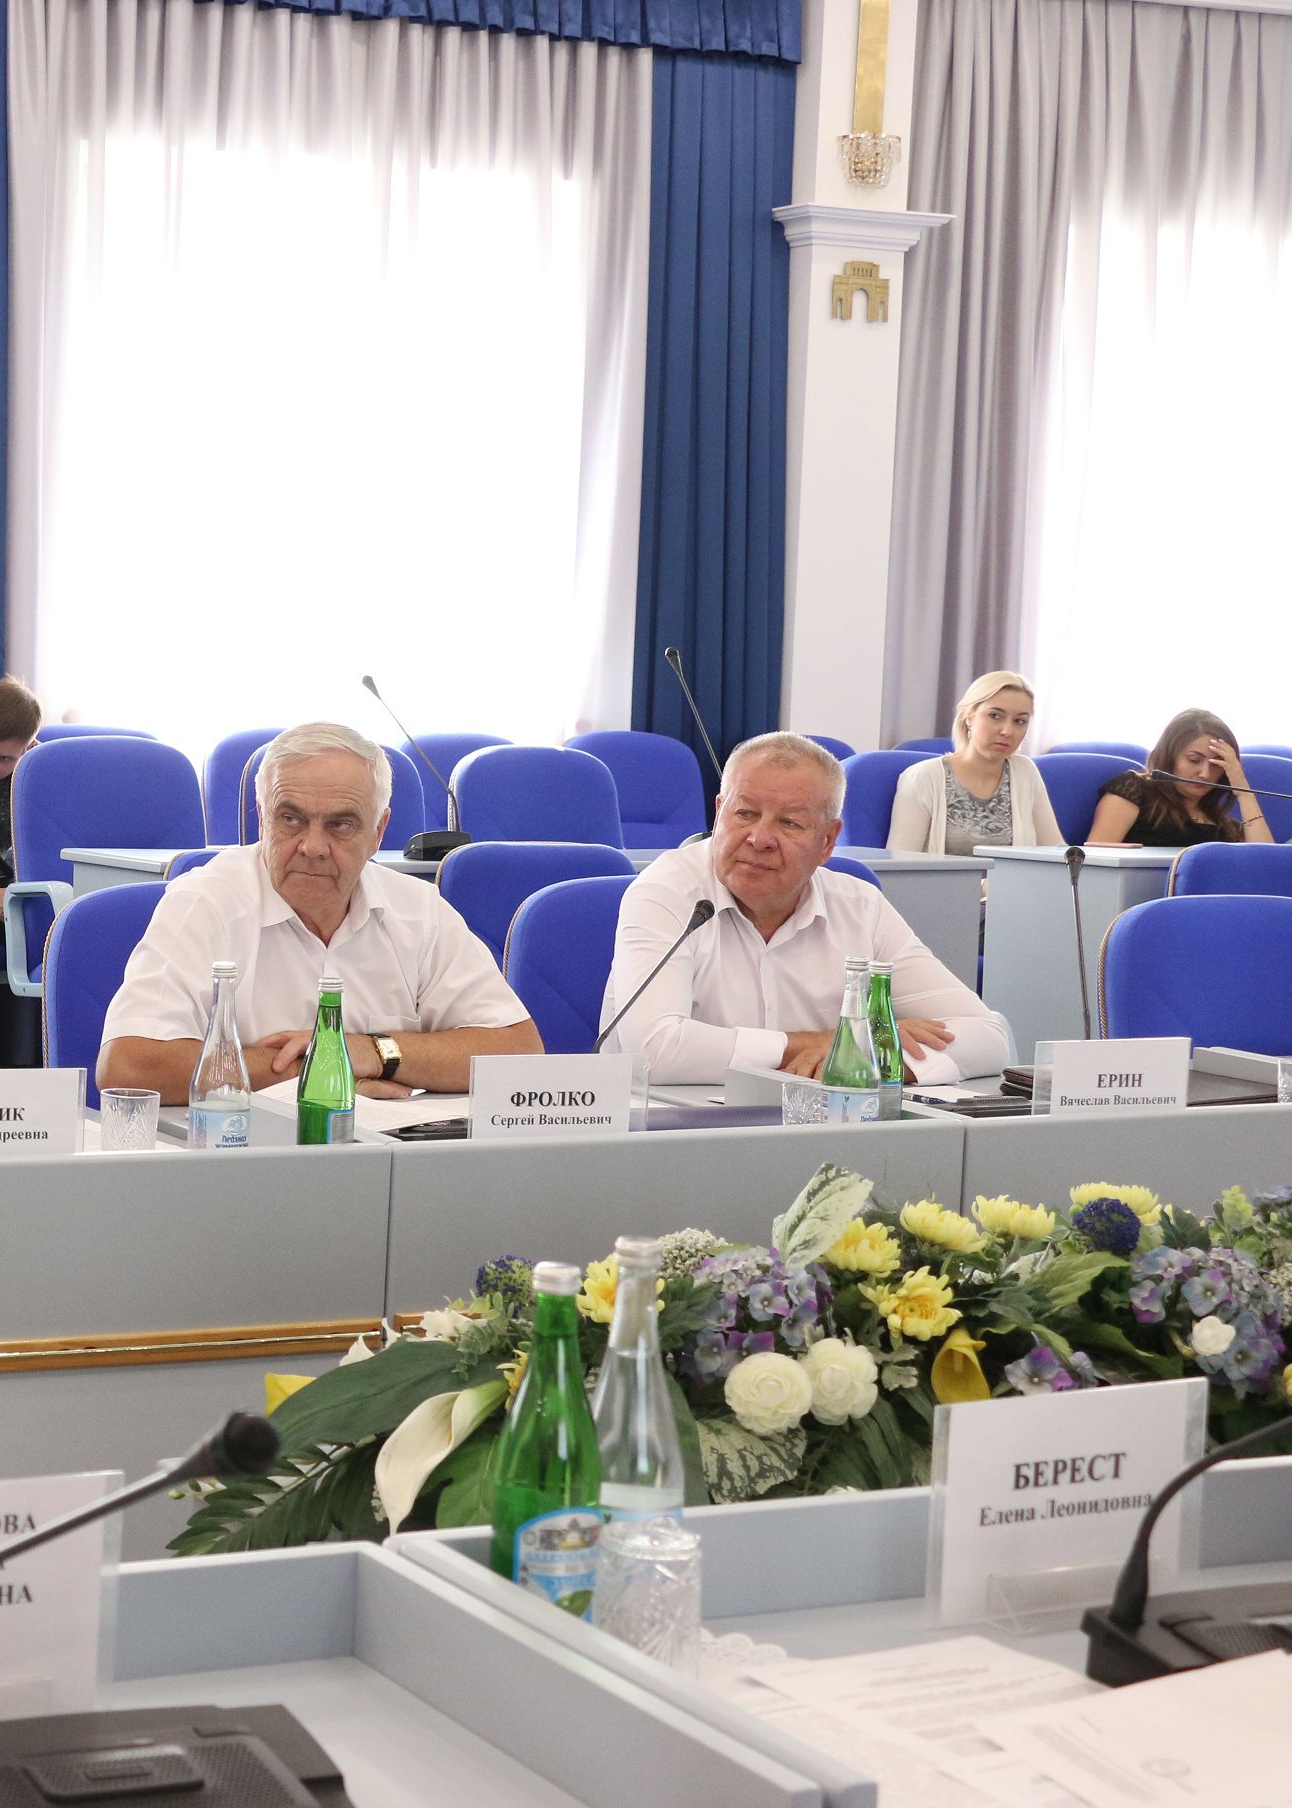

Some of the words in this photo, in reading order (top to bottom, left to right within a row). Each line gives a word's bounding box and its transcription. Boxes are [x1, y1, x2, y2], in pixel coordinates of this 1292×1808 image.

[1096, 1073, 1144, 1089] ЕРИН
[510, 1090, 596, 1107] ФРОЛКО
[1060, 1095, 1110, 1107] Вячеслав
[1113, 1094, 1177, 1106] Васильевич
[491, 1114, 535, 1128] Сергей
[539, 1114, 612, 1126] Васильевич
[1012, 1452, 1126, 1491] БЕРЕСТ
[979, 1506, 1036, 1527] Елена
[1041, 1493, 1154, 1519] Леонидовна
